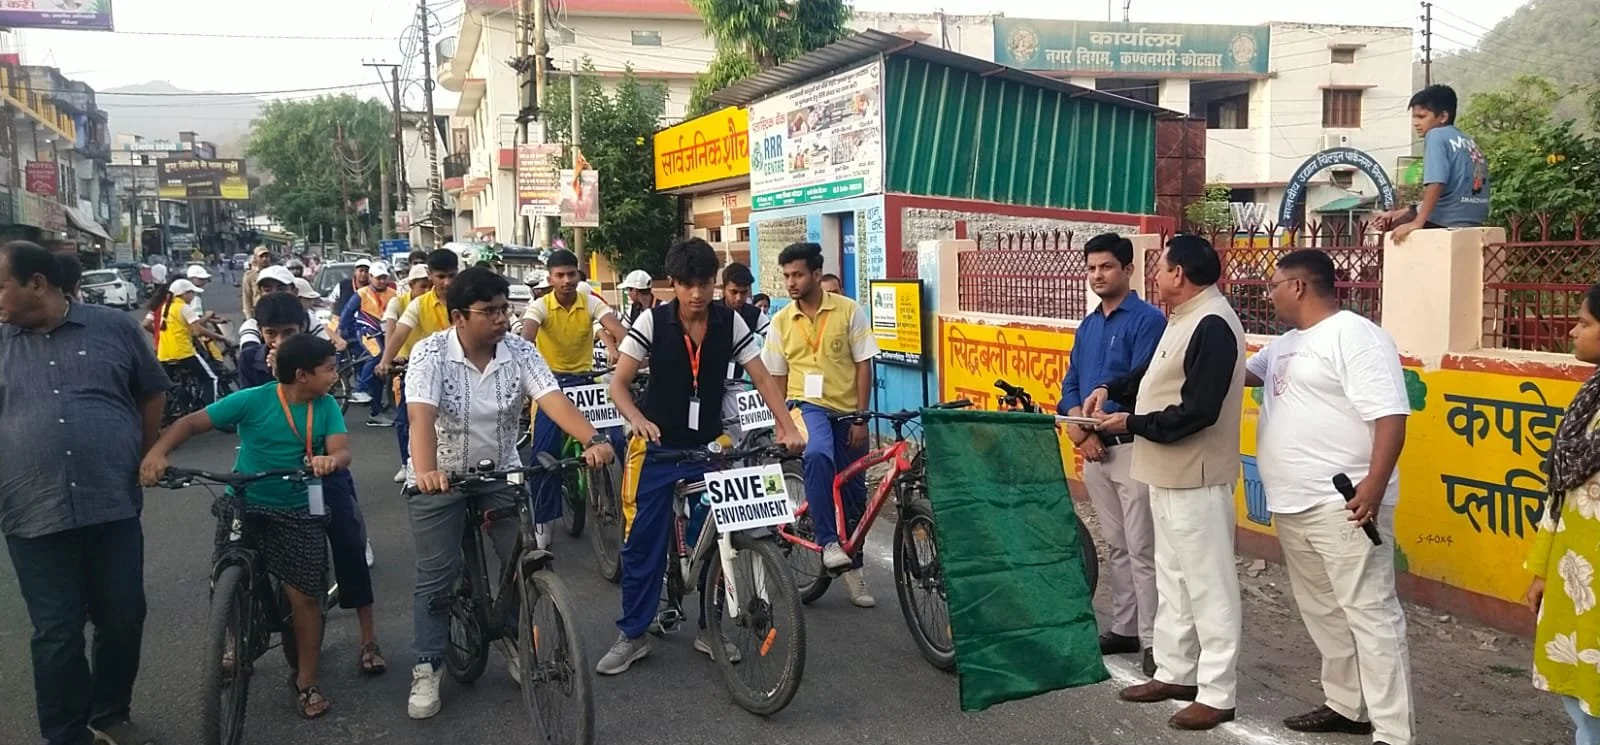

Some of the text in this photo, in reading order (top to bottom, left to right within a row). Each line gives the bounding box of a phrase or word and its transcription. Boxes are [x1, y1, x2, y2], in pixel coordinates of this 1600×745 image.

[1088, 27, 1184, 48] कार्यालय
[1045, 49, 1072, 65] नगर
[661, 130, 721, 176] सार्वजनिक
[764, 134, 783, 160] RRR
[764, 159, 785, 176] CENTRE
[1009, 334, 1071, 391] कोटद्वा
[738, 393, 765, 411] SAV
[708, 474, 765, 504] SAVE
[714, 499, 789, 526] ENVIRONMENT
